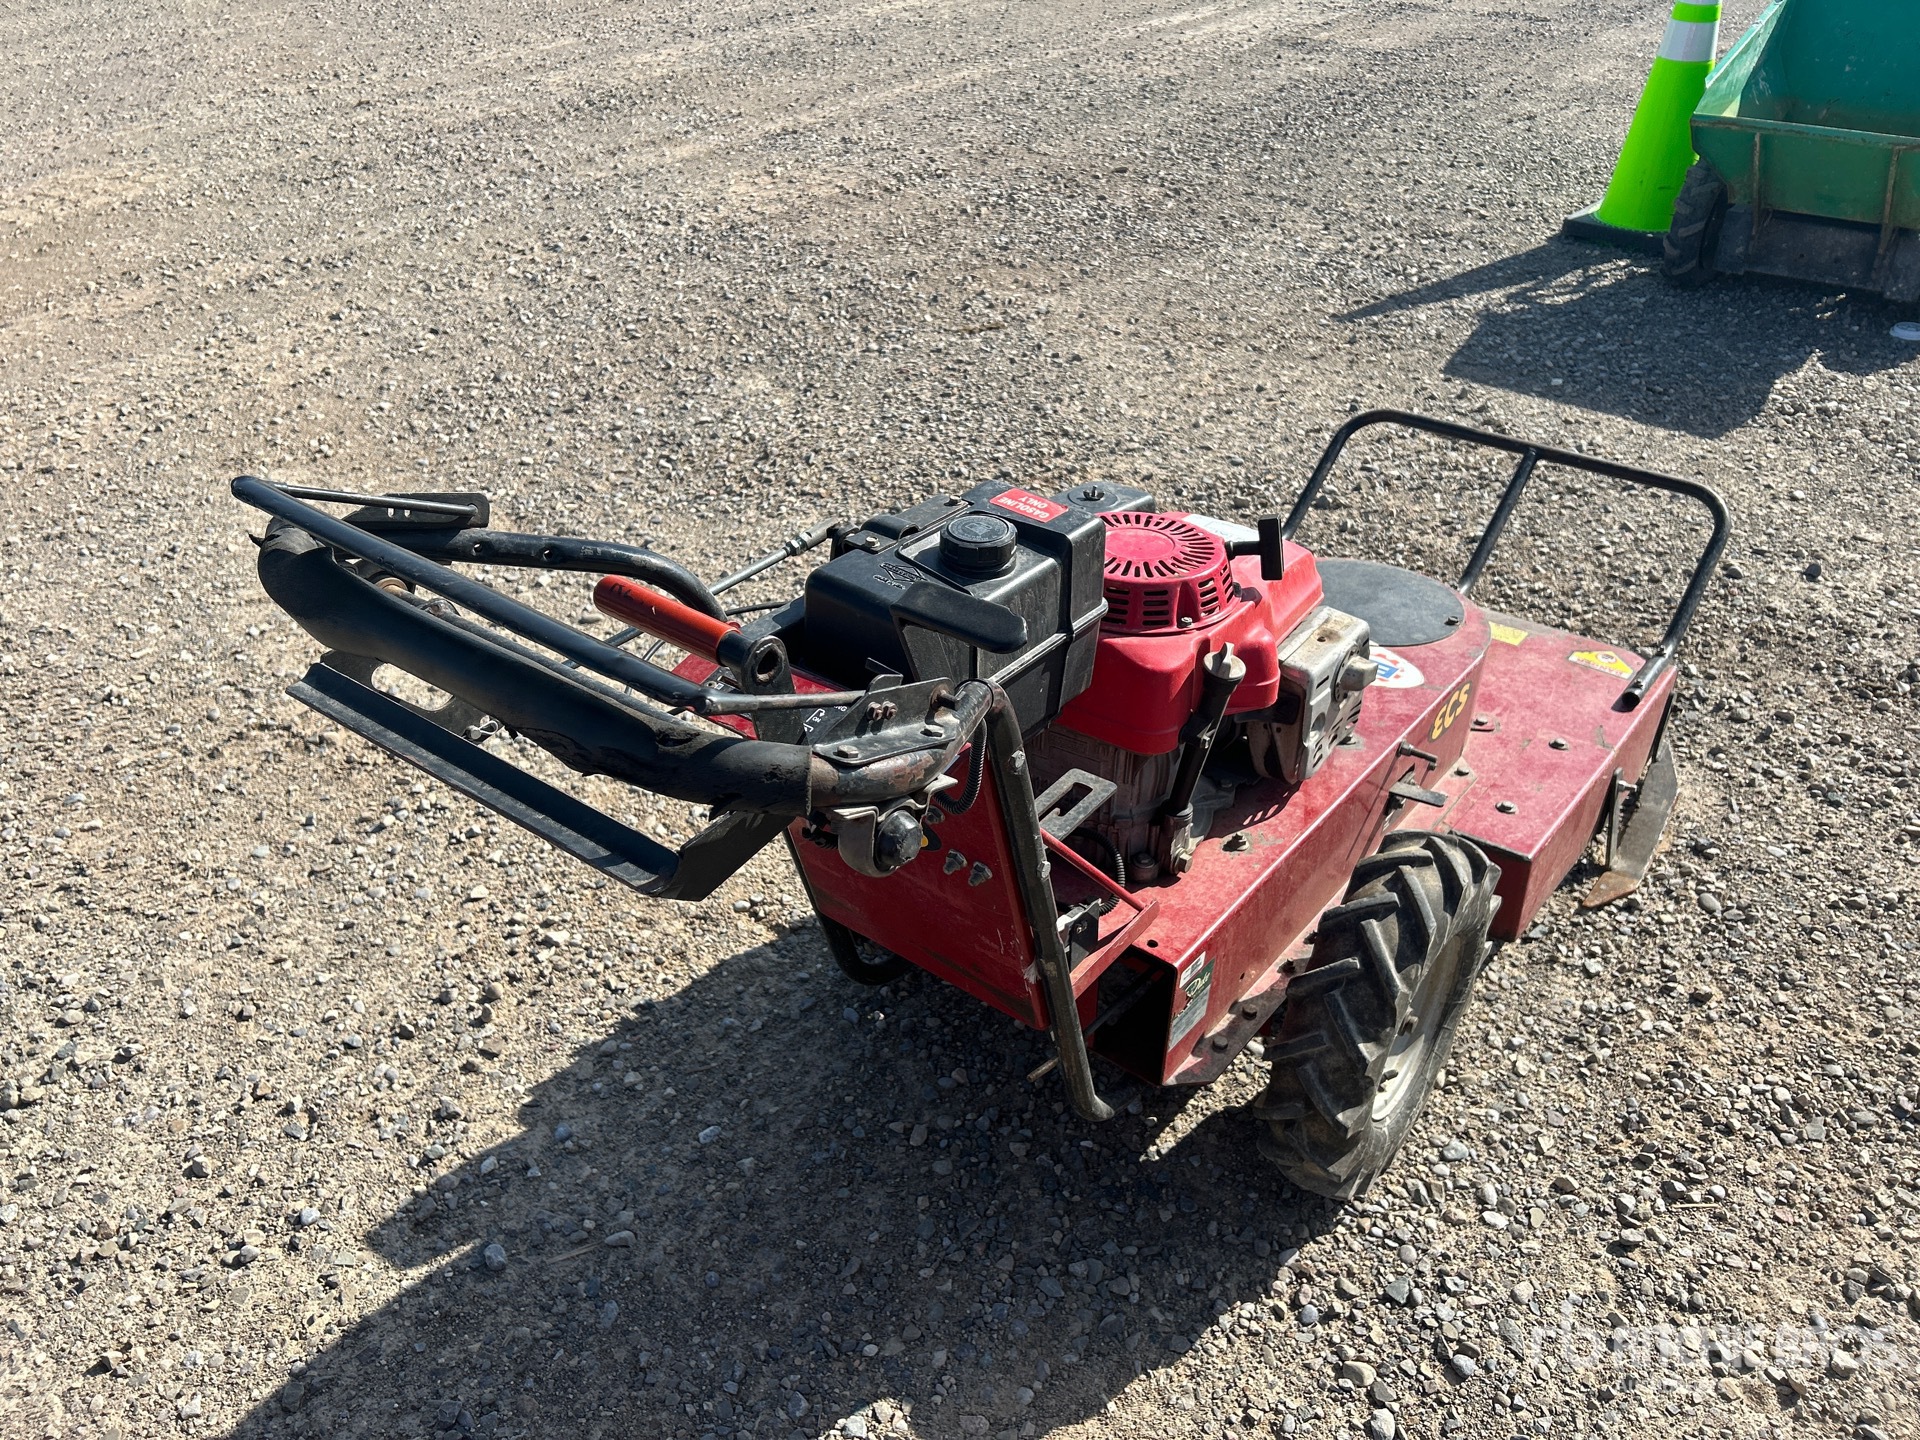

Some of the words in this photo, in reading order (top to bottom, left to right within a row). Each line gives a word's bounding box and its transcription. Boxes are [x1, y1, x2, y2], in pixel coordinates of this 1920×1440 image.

[997, 497, 1050, 519] GASOLINE
[1017, 496, 1048, 509] ONLY
[1432, 683, 1470, 740] ECS
